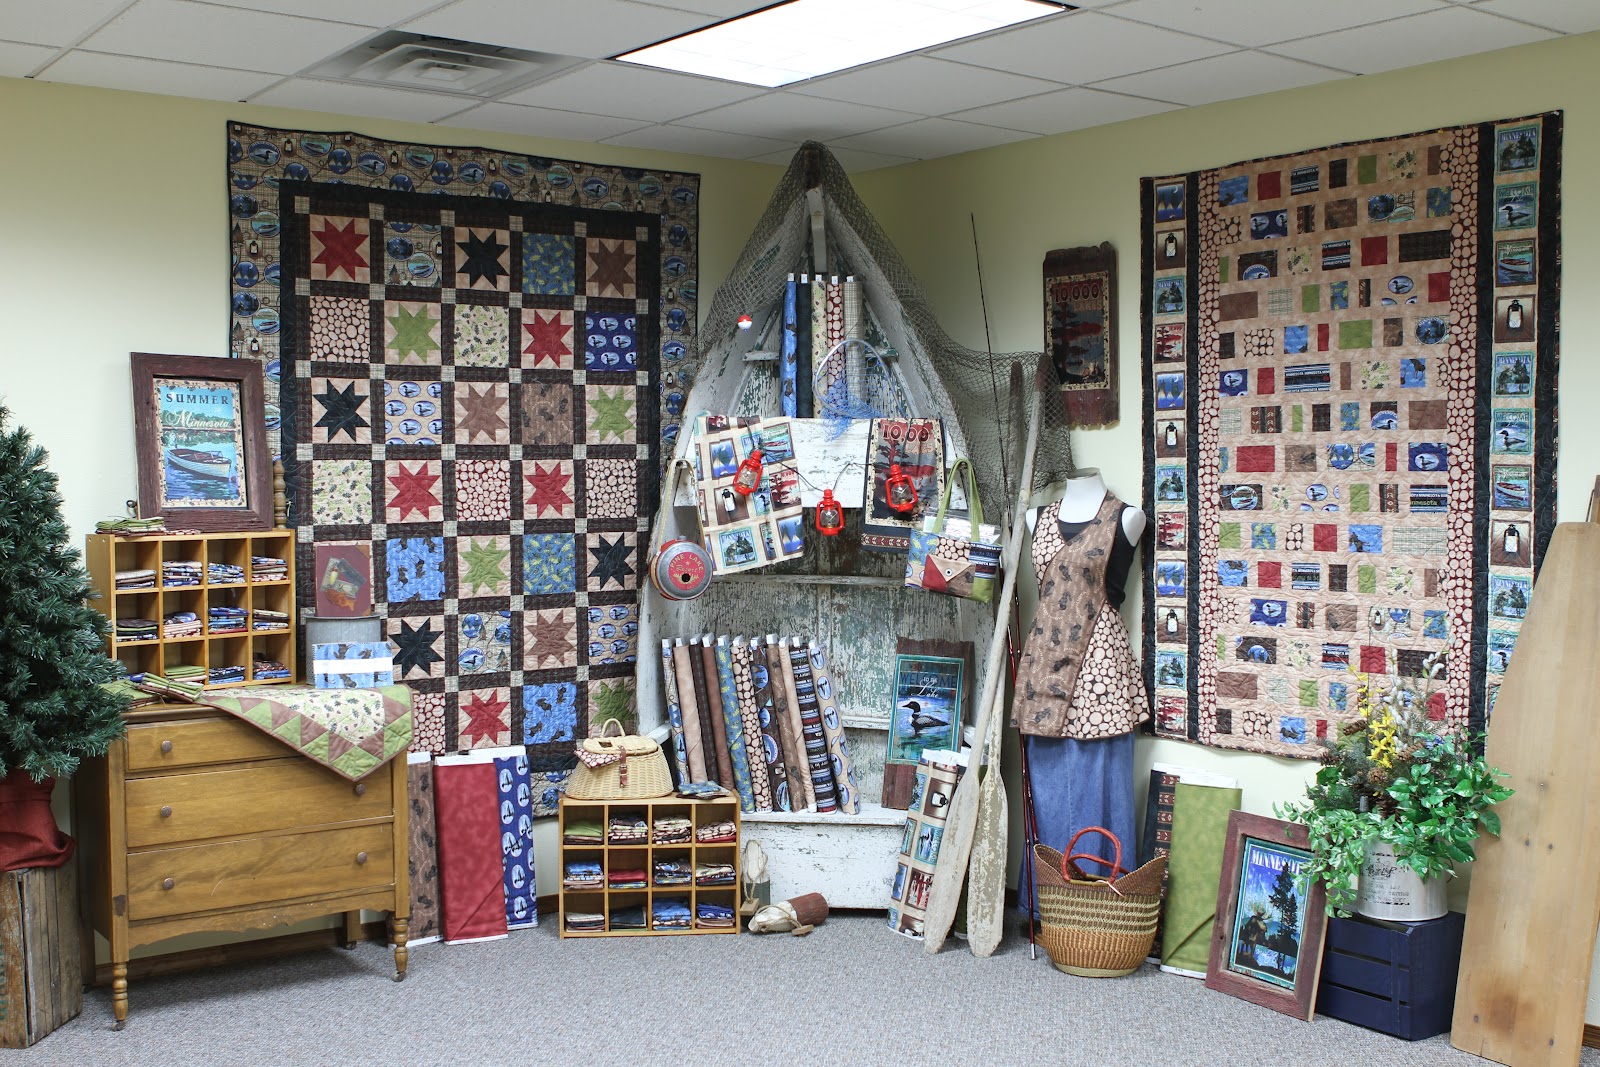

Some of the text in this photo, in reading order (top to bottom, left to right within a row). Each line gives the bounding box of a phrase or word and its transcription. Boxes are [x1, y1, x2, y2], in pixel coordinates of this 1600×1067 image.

[1055, 283, 1100, 303] 10,000
[166, 393, 229, 405] SUMMER
[165, 408, 229, 428] Minnesota
[670, 553, 704, 571] PINE LAKE
[900, 672, 957, 688] WELCOME
[911, 680, 939, 698] Lake
